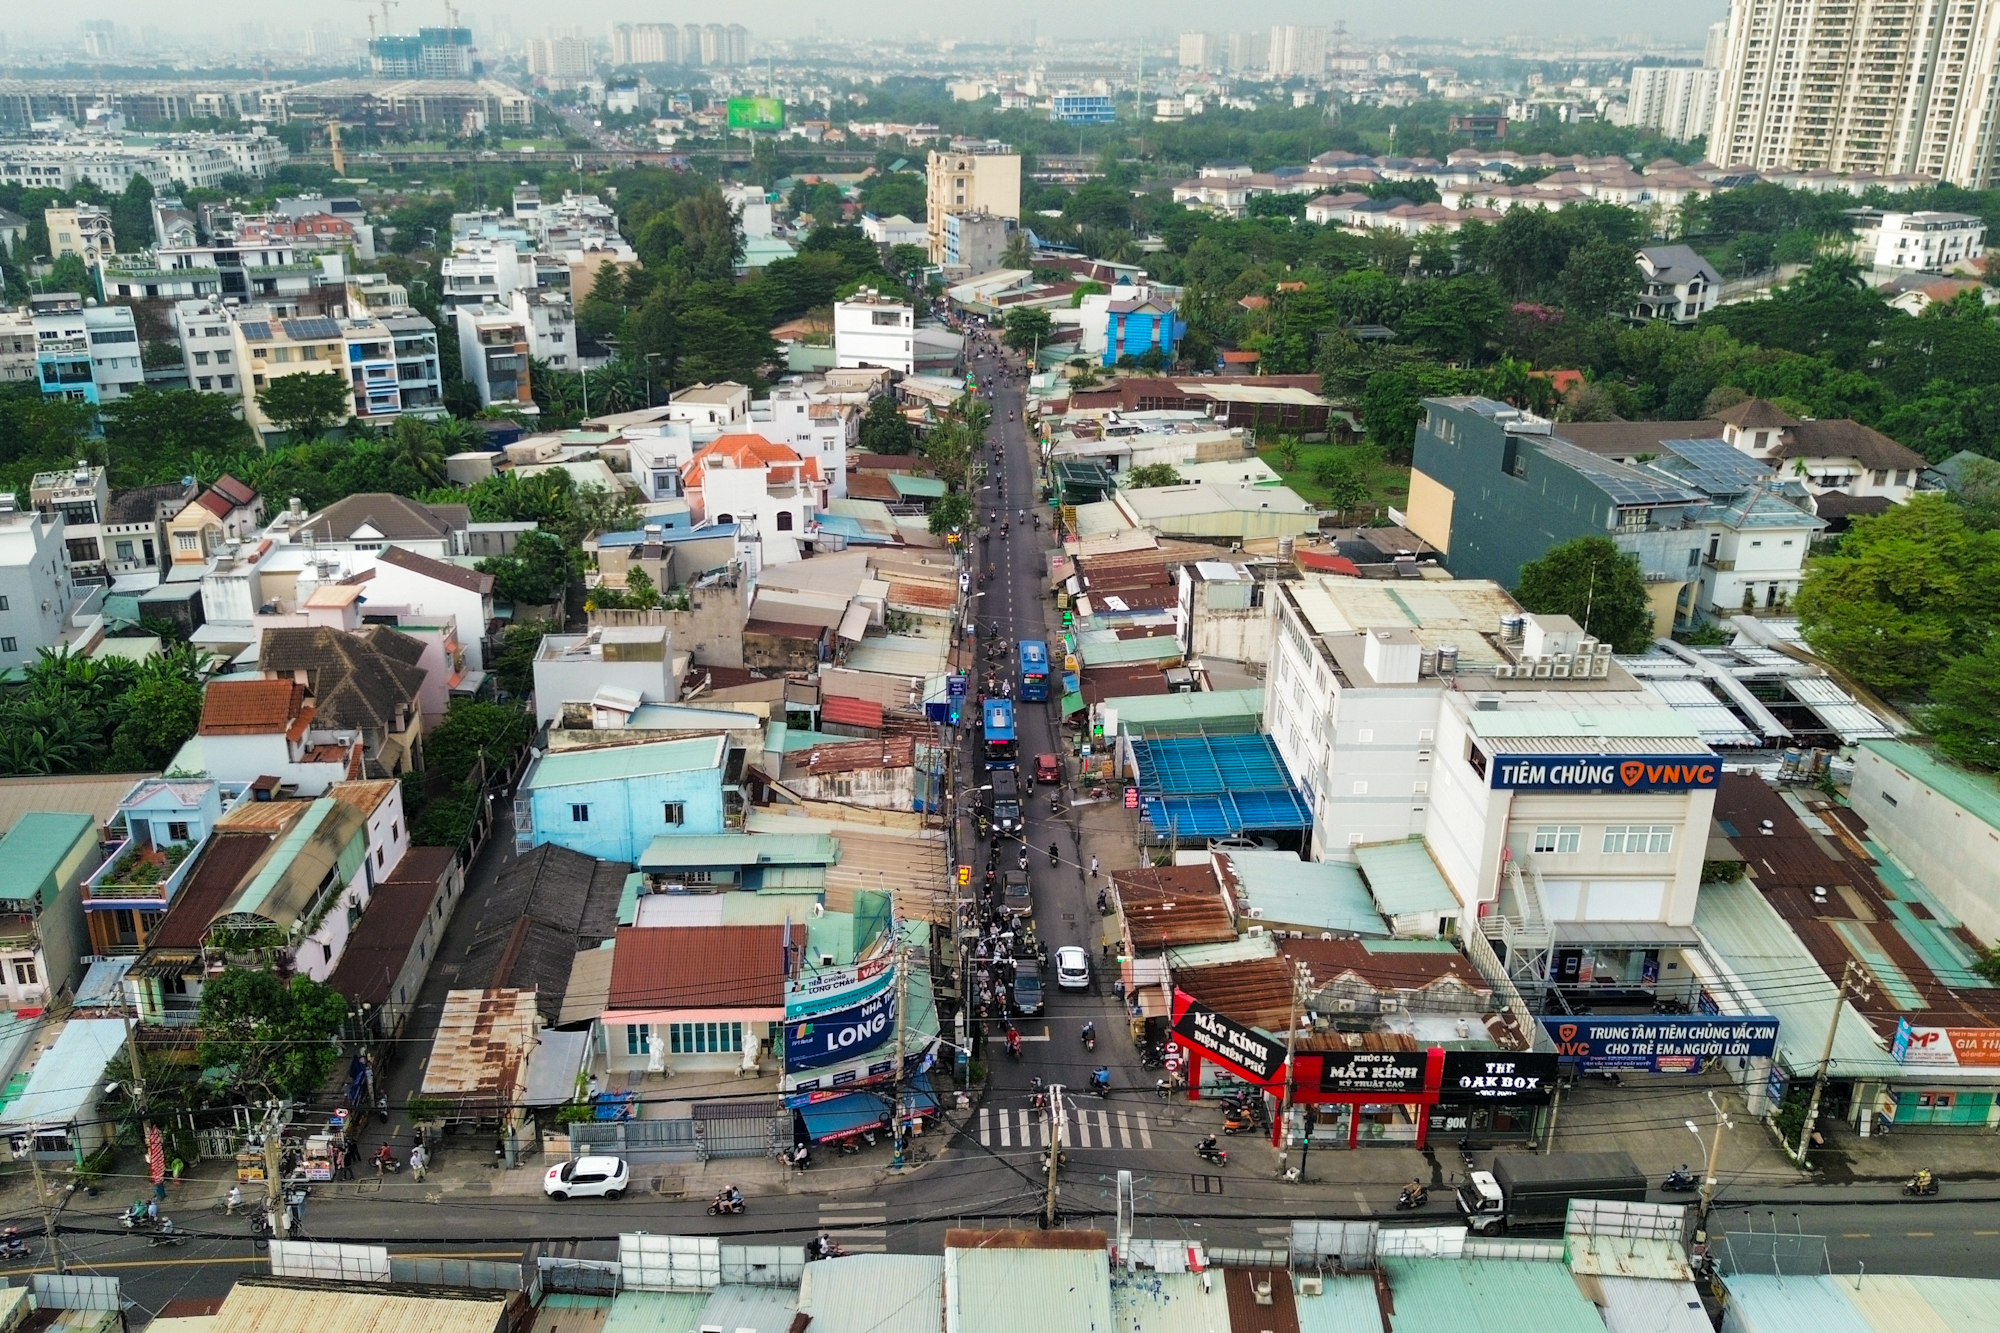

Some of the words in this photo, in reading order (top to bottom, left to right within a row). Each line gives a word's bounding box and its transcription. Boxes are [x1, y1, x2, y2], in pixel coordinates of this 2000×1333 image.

[1501, 761, 1545, 784] TIÊM
[1550, 759, 1614, 784] CHỦNG
[1646, 765, 1715, 783] VNVC
[808, 977, 823, 987] TIÊM
[823, 974, 847, 984] CHỦNG
[808, 984, 832, 995] LONG
[833, 977, 856, 988] CHÂU
[827, 1013, 886, 1050] LONG
[1194, 1011, 1227, 1038] MẮT
[1228, 1032, 1268, 1061] KÍNH
[1589, 1027, 1629, 1040] TRUNG
[1631, 1024, 1657, 1039] TÂM
[1659, 1024, 1688, 1039] TIÊM
[1688, 1023, 1731, 1040] CHỦNG
[1732, 1022, 1753, 1040] VẮC
[1753, 1027, 1775, 1039] XIN
[1605, 1043, 1630, 1055] CHO
[1631, 1039, 1654, 1055] TRẺ
[1656, 1043, 1675, 1055] EM
[1675, 1047, 1682, 1055] &
[1682, 1040, 1722, 1055] NGƯỜI
[1724, 1039, 1750, 1055] LỚN
[1956, 1040, 1977, 1049] GIA
[1194, 1030, 1218, 1050] ĐIỆN
[1219, 1044, 1243, 1063] BIÊN
[1244, 1056, 1266, 1075] PHỦ
[1354, 1054, 1380, 1062] KHÚC
[1329, 1061, 1368, 1078] MẮT
[1371, 1064, 1418, 1078] KÍNH
[1485, 1063, 1515, 1073] THE
[1354, 1080, 1384, 1088] THUẬT
[1459, 1076, 1498, 1088] OAK
[1501, 1076, 1539, 1089] BOX
[1446, 1117, 1467, 1128] 90K
[838, 1129, 857, 1138] HÀNG
